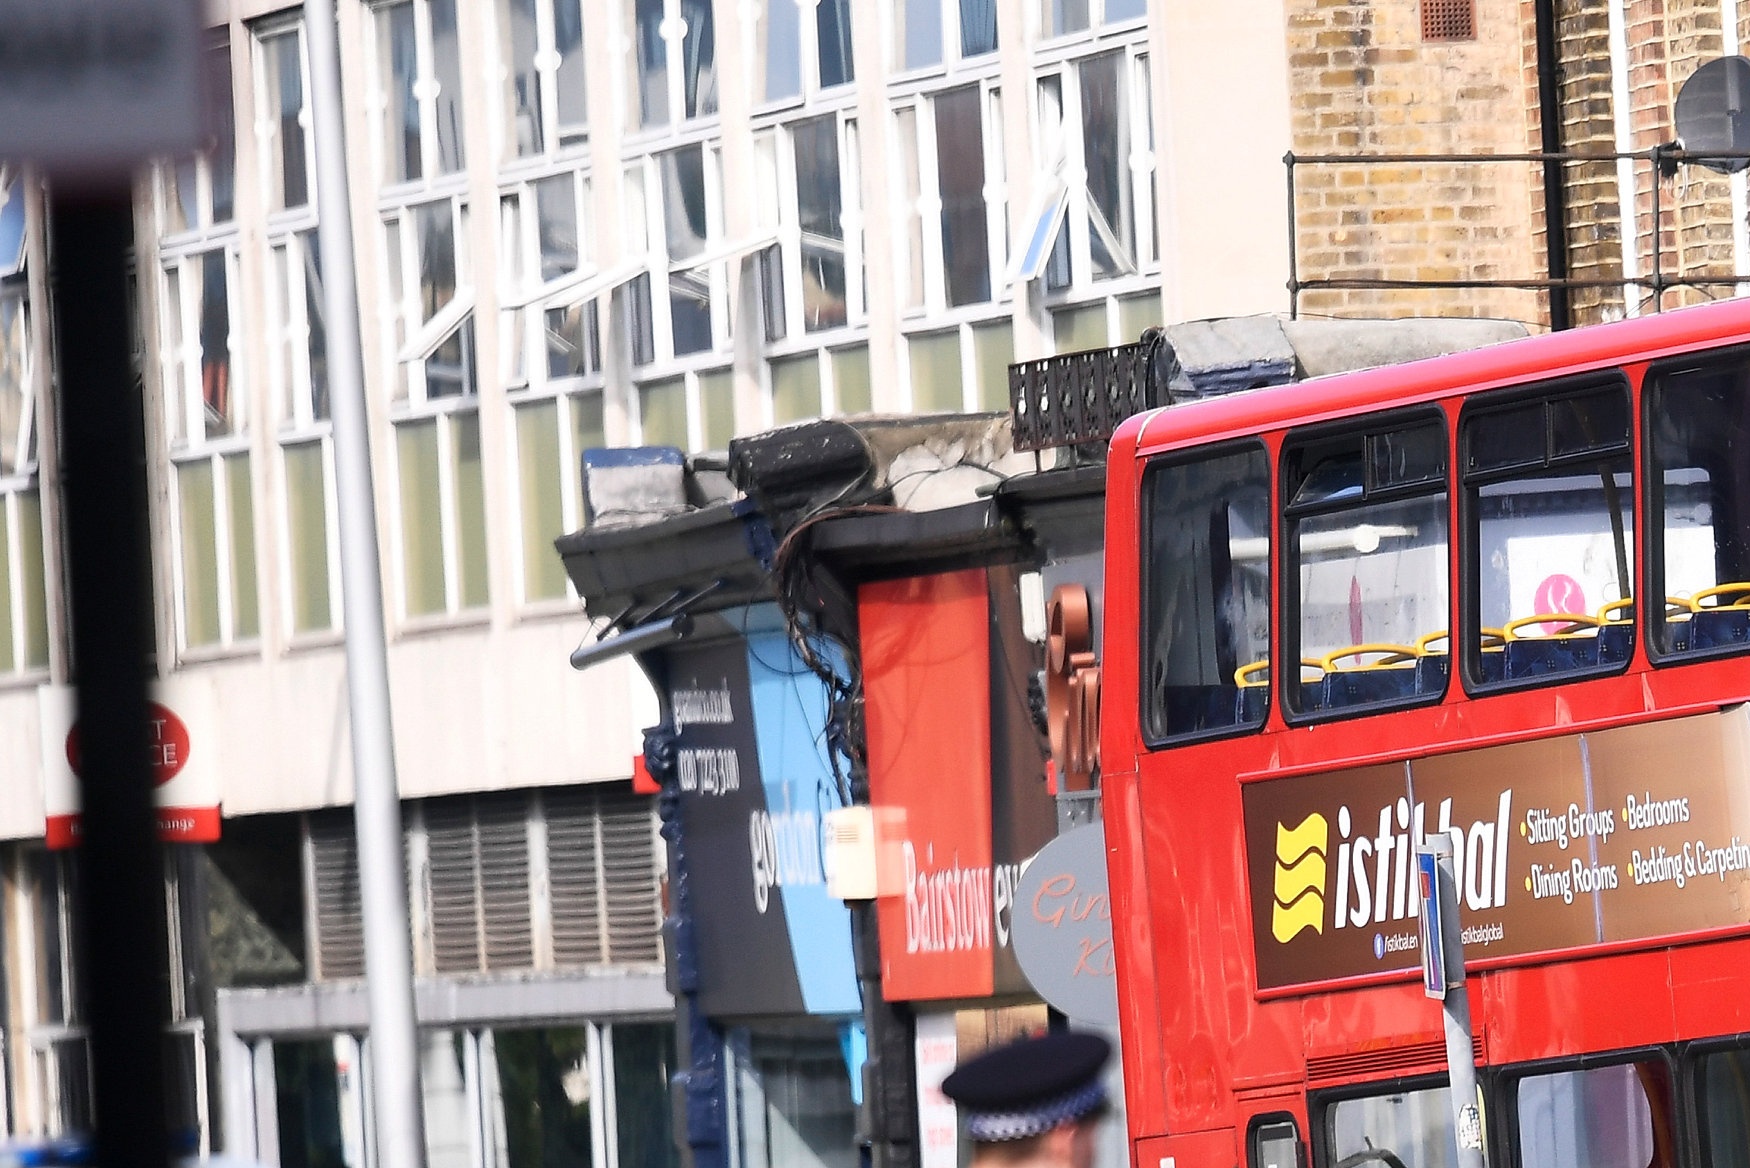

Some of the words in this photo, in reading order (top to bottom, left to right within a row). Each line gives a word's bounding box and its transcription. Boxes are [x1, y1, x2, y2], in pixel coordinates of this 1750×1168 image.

[1526, 807, 1568, 850] Sitting
[1568, 803, 1615, 844] Groups
[1626, 791, 1691, 831] Bedrooms
[902, 840, 990, 954] Bairstow
[1531, 863, 1573, 905] Dining
[1571, 858, 1618, 892] Rooms
[1632, 845, 1685, 889] Bedding
[1683, 841, 1697, 878] &
